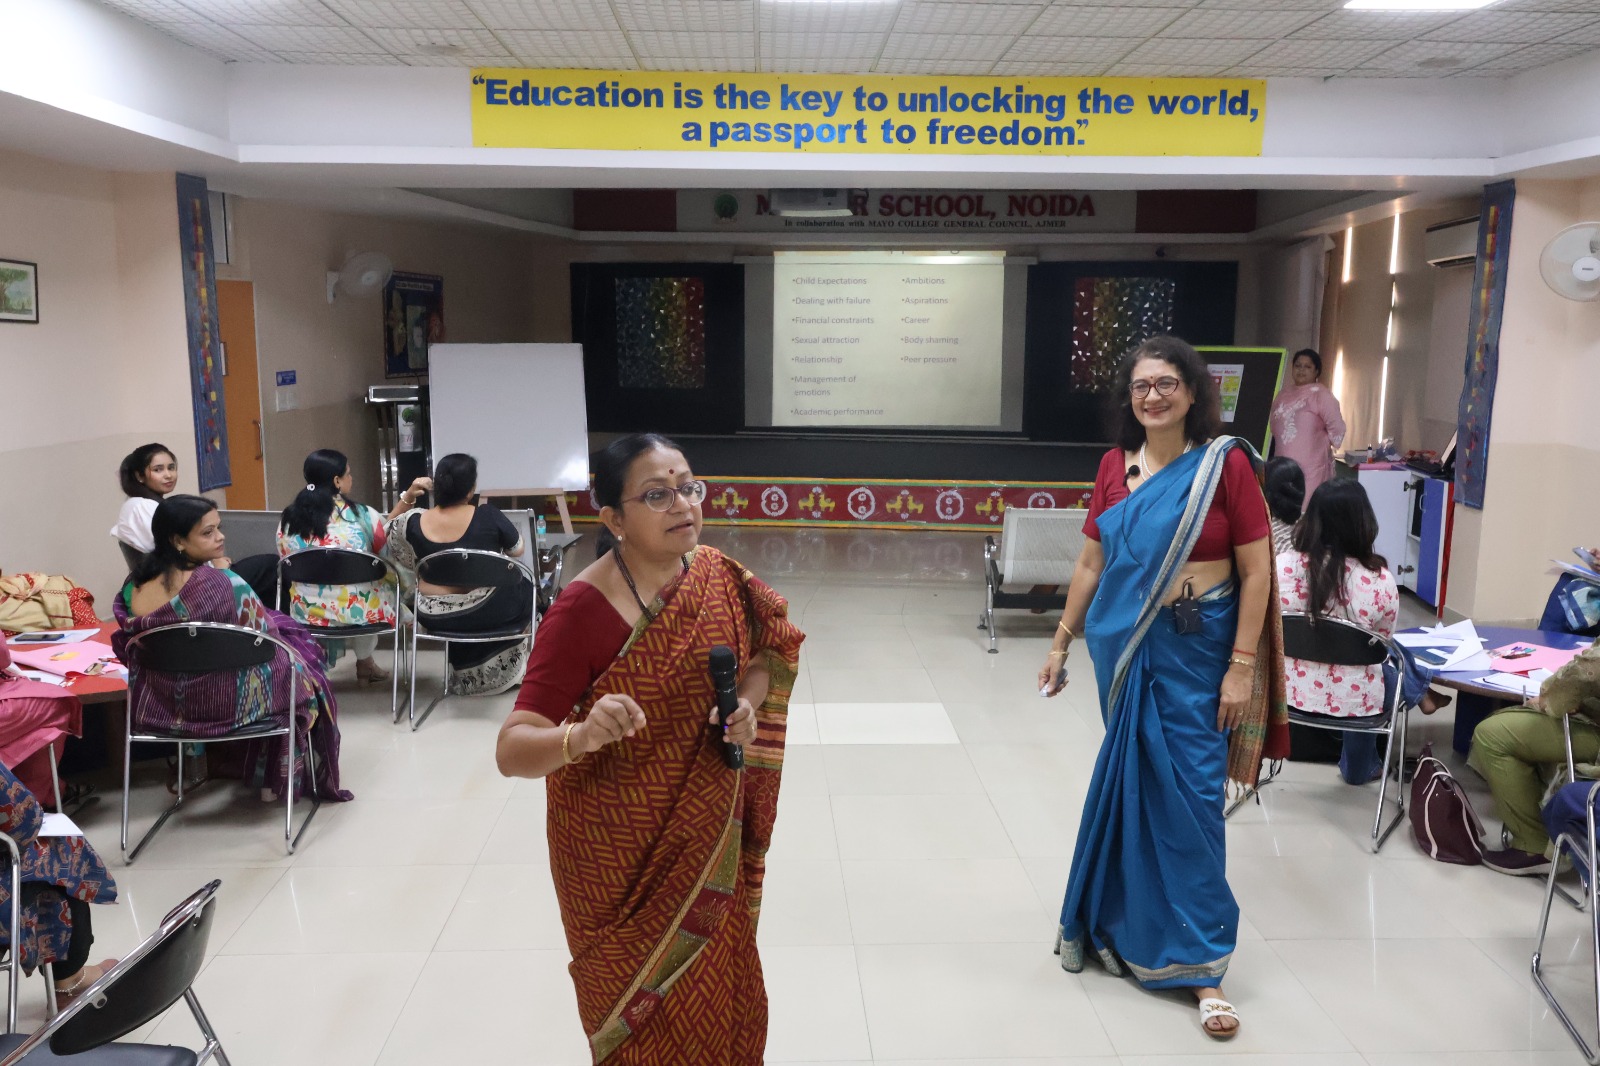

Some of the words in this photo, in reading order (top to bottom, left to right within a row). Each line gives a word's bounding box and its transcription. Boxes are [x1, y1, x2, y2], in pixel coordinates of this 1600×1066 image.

[472, 74, 664, 109] “Education
[674, 82, 704, 109] is
[713, 81, 771, 111] the
[780, 83, 843, 118] key
[853, 86, 889, 112] to
[897, 85, 1066, 123] unlocking
[1077, 88, 1135, 115] the
[1148, 89, 1259, 123] world,
[681, 121, 703, 143] a
[709, 118, 868, 149] passport
[880, 118, 917, 145] to
[926, 117, 1090, 146] freedom.”
[878, 193, 996, 220] SCHOOL,
[1006, 193, 1097, 217] NOIDA
[785, 219, 793, 227] In
[796, 219, 845, 227] collaboration
[848, 219, 865, 227] with
[868, 220, 894, 228] MAYO
[898, 220, 938, 228] COLLEGE
[943, 220, 986, 228] GENERAL
[1035, 220, 1066, 228] AJMER
[795, 276, 816, 285] Child
[817, 276, 867, 286] Expectations
[904, 276, 945, 285] Ambitions
[795, 296, 825, 306] Dealing
[826, 296, 844, 304] with
[845, 296, 871, 304] failure
[904, 296, 949, 306] Aspirations
[795, 316, 830, 324] Financial
[831, 316, 875, 324] constraints
[904, 316, 930, 324] Career
[794, 336, 820, 344] Sexual
[821, 336, 860, 344] attraction
[904, 335, 924, 345] Body
[925, 335, 959, 346] shaming
[794, 355, 843, 365] Relationship
[903, 355, 922, 363] Peer
[923, 356, 957, 365] pressure
[794, 375, 846, 385] Management
[848, 375, 857, 383] of
[793, 408, 832, 416] Academic
[833, 408, 884, 417] performance
